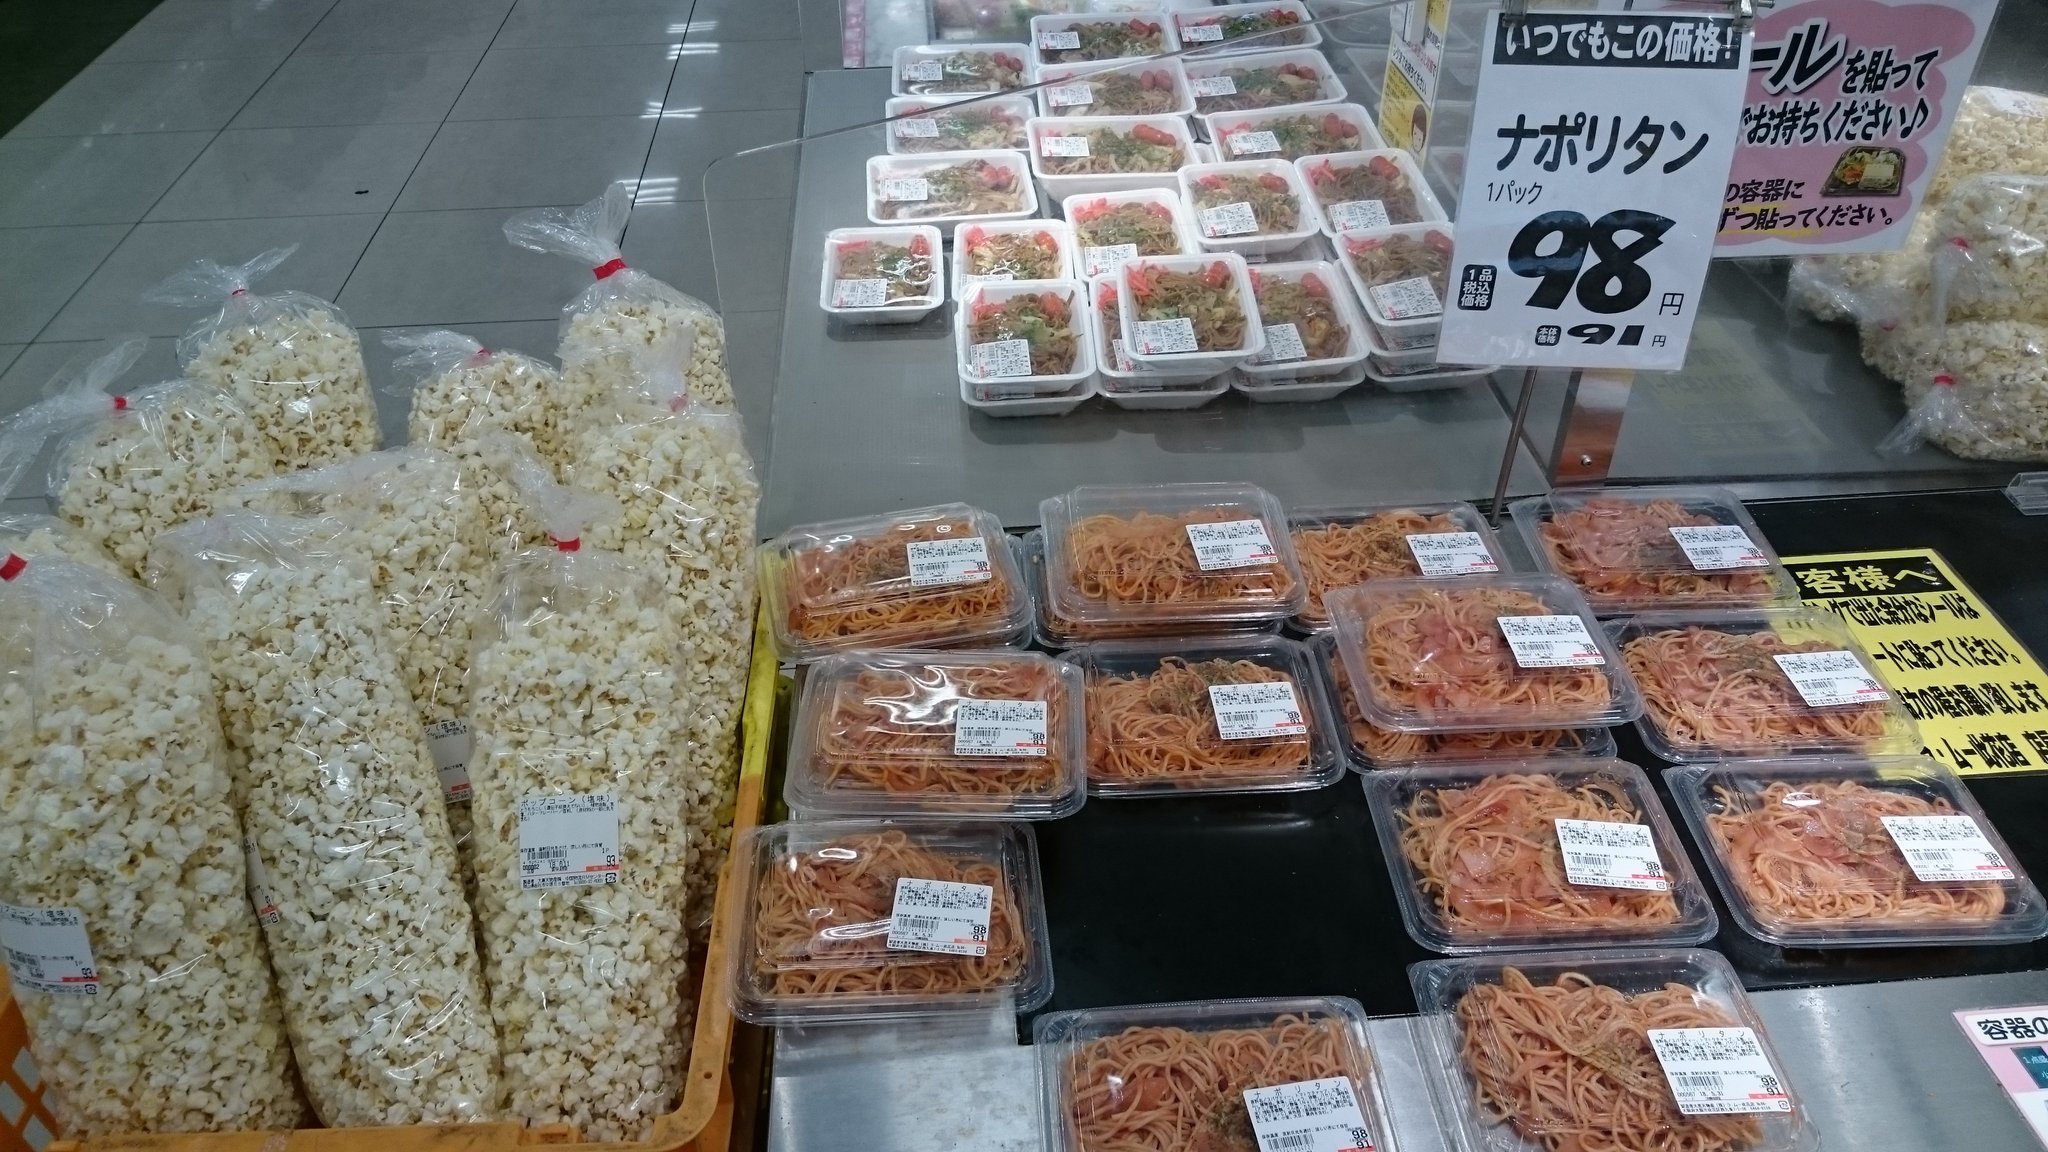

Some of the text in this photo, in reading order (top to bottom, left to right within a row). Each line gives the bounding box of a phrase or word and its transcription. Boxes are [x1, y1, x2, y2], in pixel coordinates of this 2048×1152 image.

[1506, 21, 1733, 63] いつでもこの価格!
[1496, 111, 1710, 174] ナポリタン
[1487, 180, 1543, 205] 1パック
[1508, 209, 1677, 314] 98
[1658, 292, 1685, 316] 円
[1462, 281, 1491, 295] 税込
[1460, 294, 1489, 308] 価格
[1567, 323, 1667, 348] 91 円
[1796, 565, 1937, 594] 客様へ
[973, 925, 987, 934] 98
[1761, 1076, 1778, 1087] 98
[1766, 1087, 1783, 1096] 91
[1352, 1128, 1368, 1140] 98
[1356, 1140, 1371, 1149] 91
